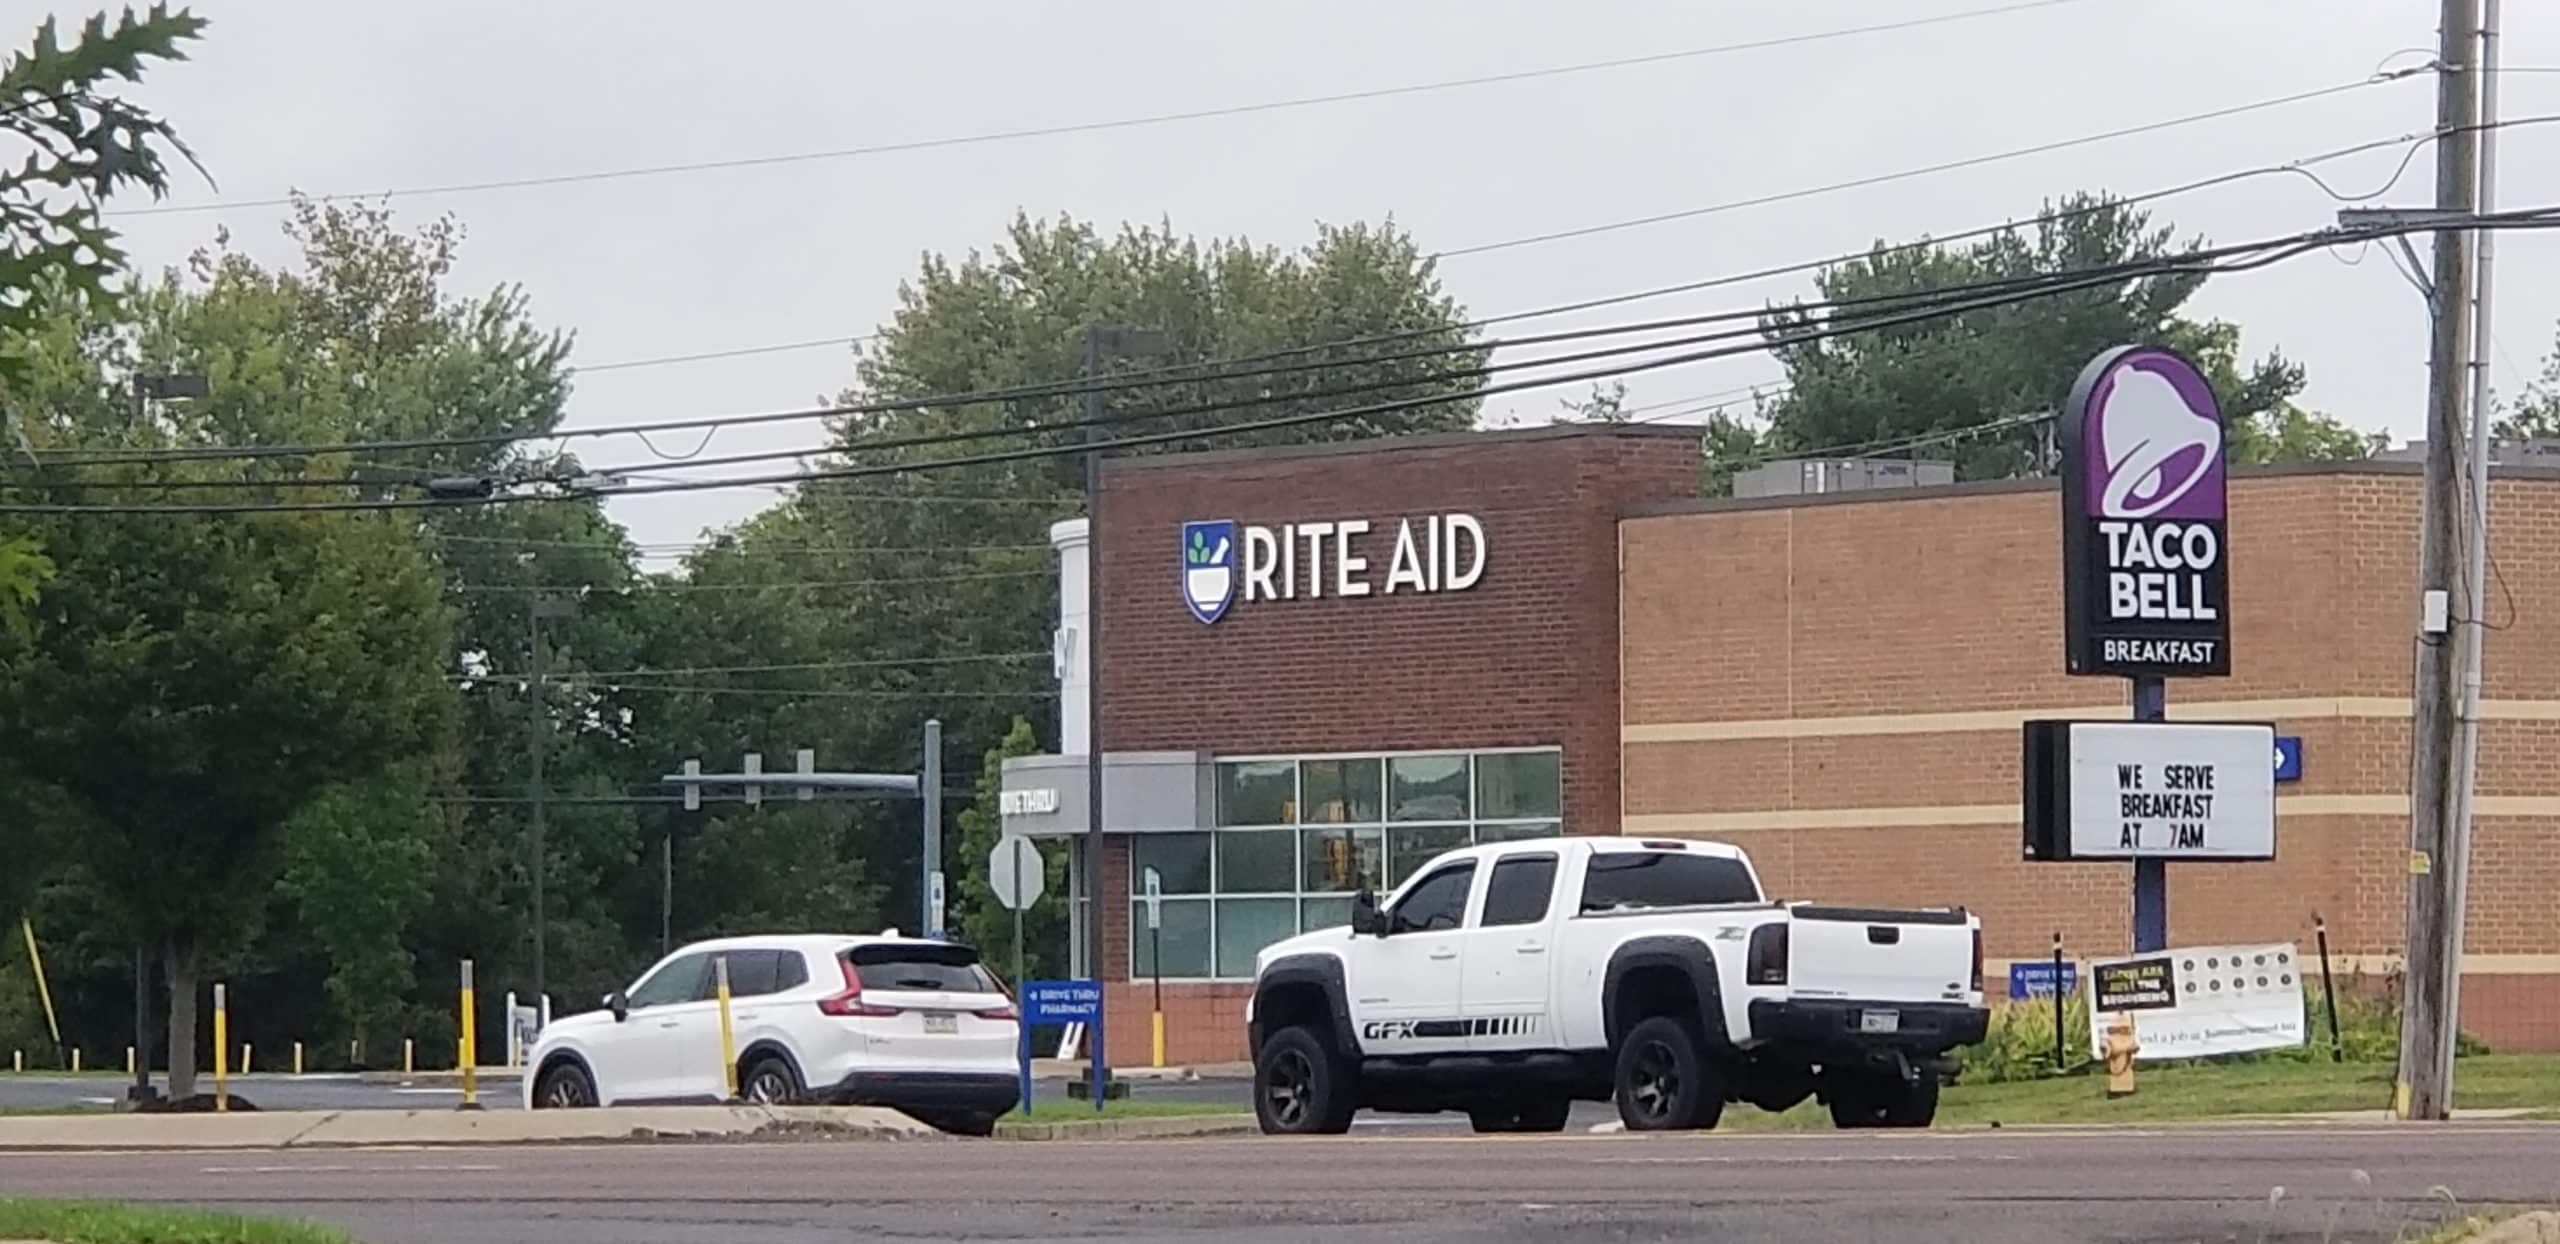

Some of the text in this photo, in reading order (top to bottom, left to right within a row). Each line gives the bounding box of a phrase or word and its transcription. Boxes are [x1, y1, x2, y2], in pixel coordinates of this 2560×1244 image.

[1245, 513, 1486, 600] RITE AID
[2099, 522, 2217, 570] TACO
[2110, 572, 2217, 619] BELL
[2104, 639, 2215, 663] BREAKFAST
[2118, 764, 2214, 790] WE SERVE
[2121, 793, 2213, 819] BREAKFAST
[2120, 822, 2204, 848] AT 7AM
[1040, 989, 1100, 1000] DRIVE THRU
[1040, 1003, 1097, 1015] PHARMACY
[1363, 1021, 1417, 1040] GFX
